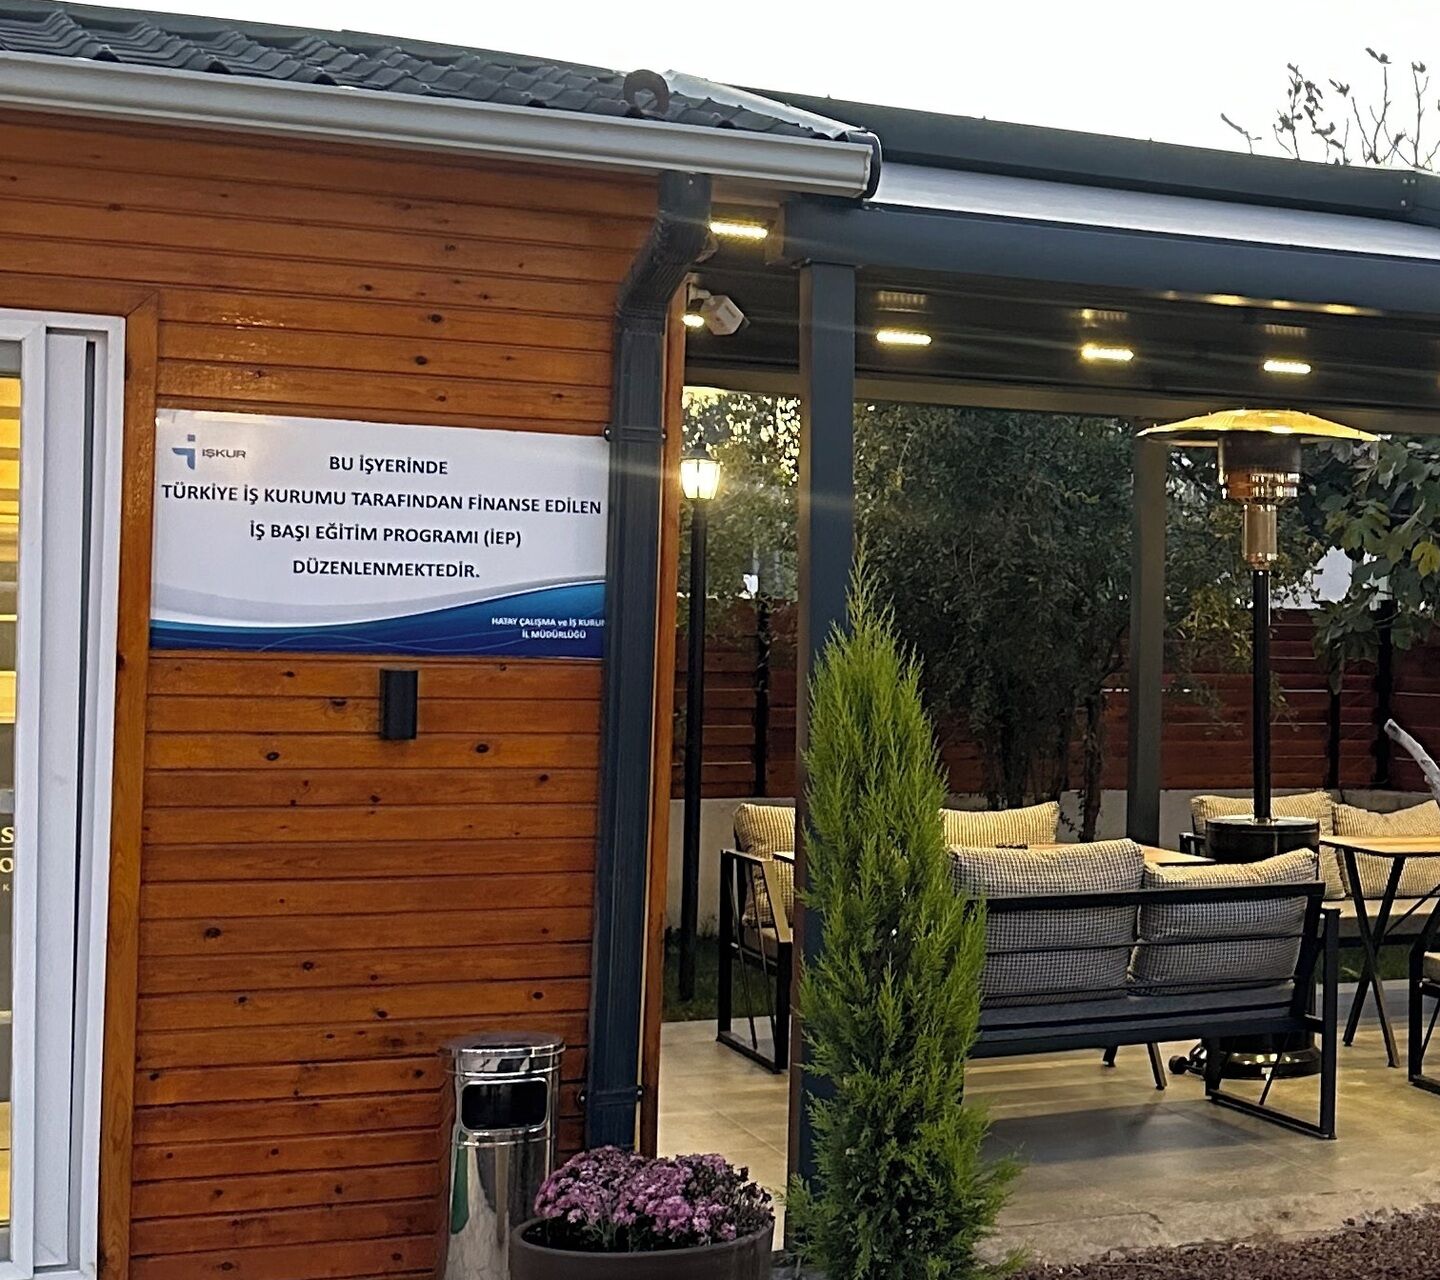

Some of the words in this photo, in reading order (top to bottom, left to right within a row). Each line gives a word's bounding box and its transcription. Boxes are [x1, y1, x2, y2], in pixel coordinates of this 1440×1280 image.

[329, 456, 354, 470] BU
[360, 455, 448, 474] İŞYERİNDE
[161, 481, 238, 501] TÜRKİYE
[244, 484, 259, 505] İŞ
[264, 488, 346, 505] KURUMU
[351, 491, 463, 510] TARAFINDAN
[468, 494, 540, 512] FİNANSE
[545, 497, 601, 515] EDİLEN
[249, 520, 265, 541] İŞ
[270, 524, 310, 542] BAŞI
[315, 522, 377, 541] EĞİTİM
[383, 527, 478, 544] PROGRAMI
[484, 528, 522, 548] (İEP)
[292, 557, 481, 578] DÜZENLENMEKTEDİR.
[519, 617, 556, 628] ÇALIŞMA
